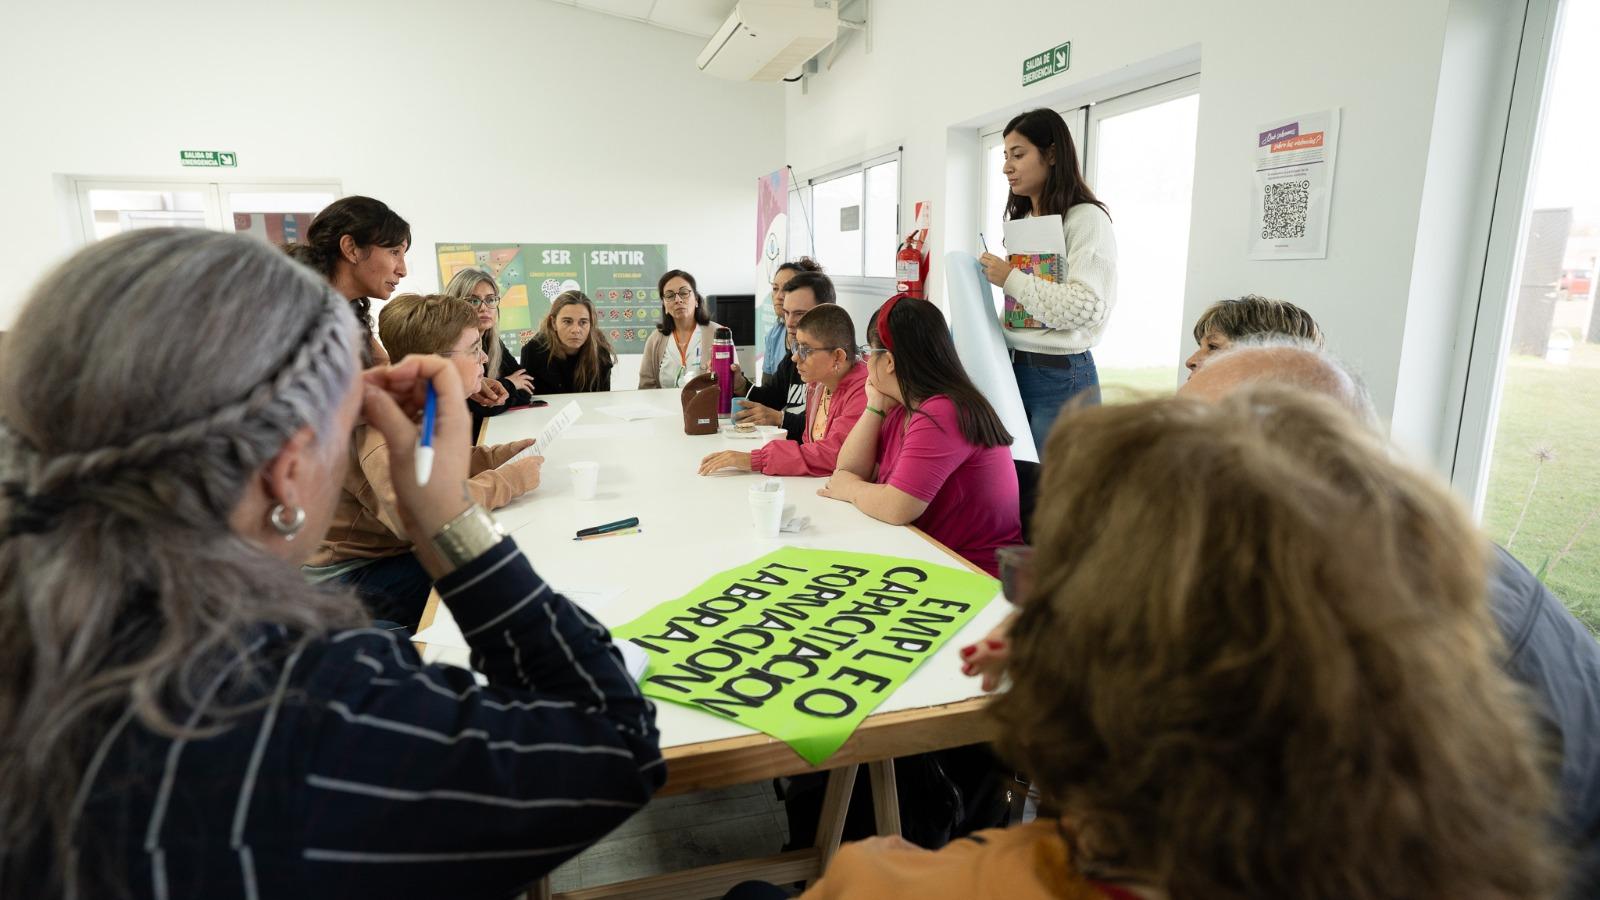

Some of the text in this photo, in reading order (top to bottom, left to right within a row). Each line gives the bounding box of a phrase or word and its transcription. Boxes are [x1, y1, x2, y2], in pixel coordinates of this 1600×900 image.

[1025, 52, 1050, 71] SALIDA DE
[1023, 64, 1053, 84] EMERGENCIA
[184, 151, 214, 160] SALIDA DE
[541, 249, 571, 265] SER
[590, 250, 645, 265] SENTIR
[646, 564, 870, 693] FORMACION
[690, 566, 928, 718] CAPACITACION
[793, 597, 971, 718] EMPLEO
